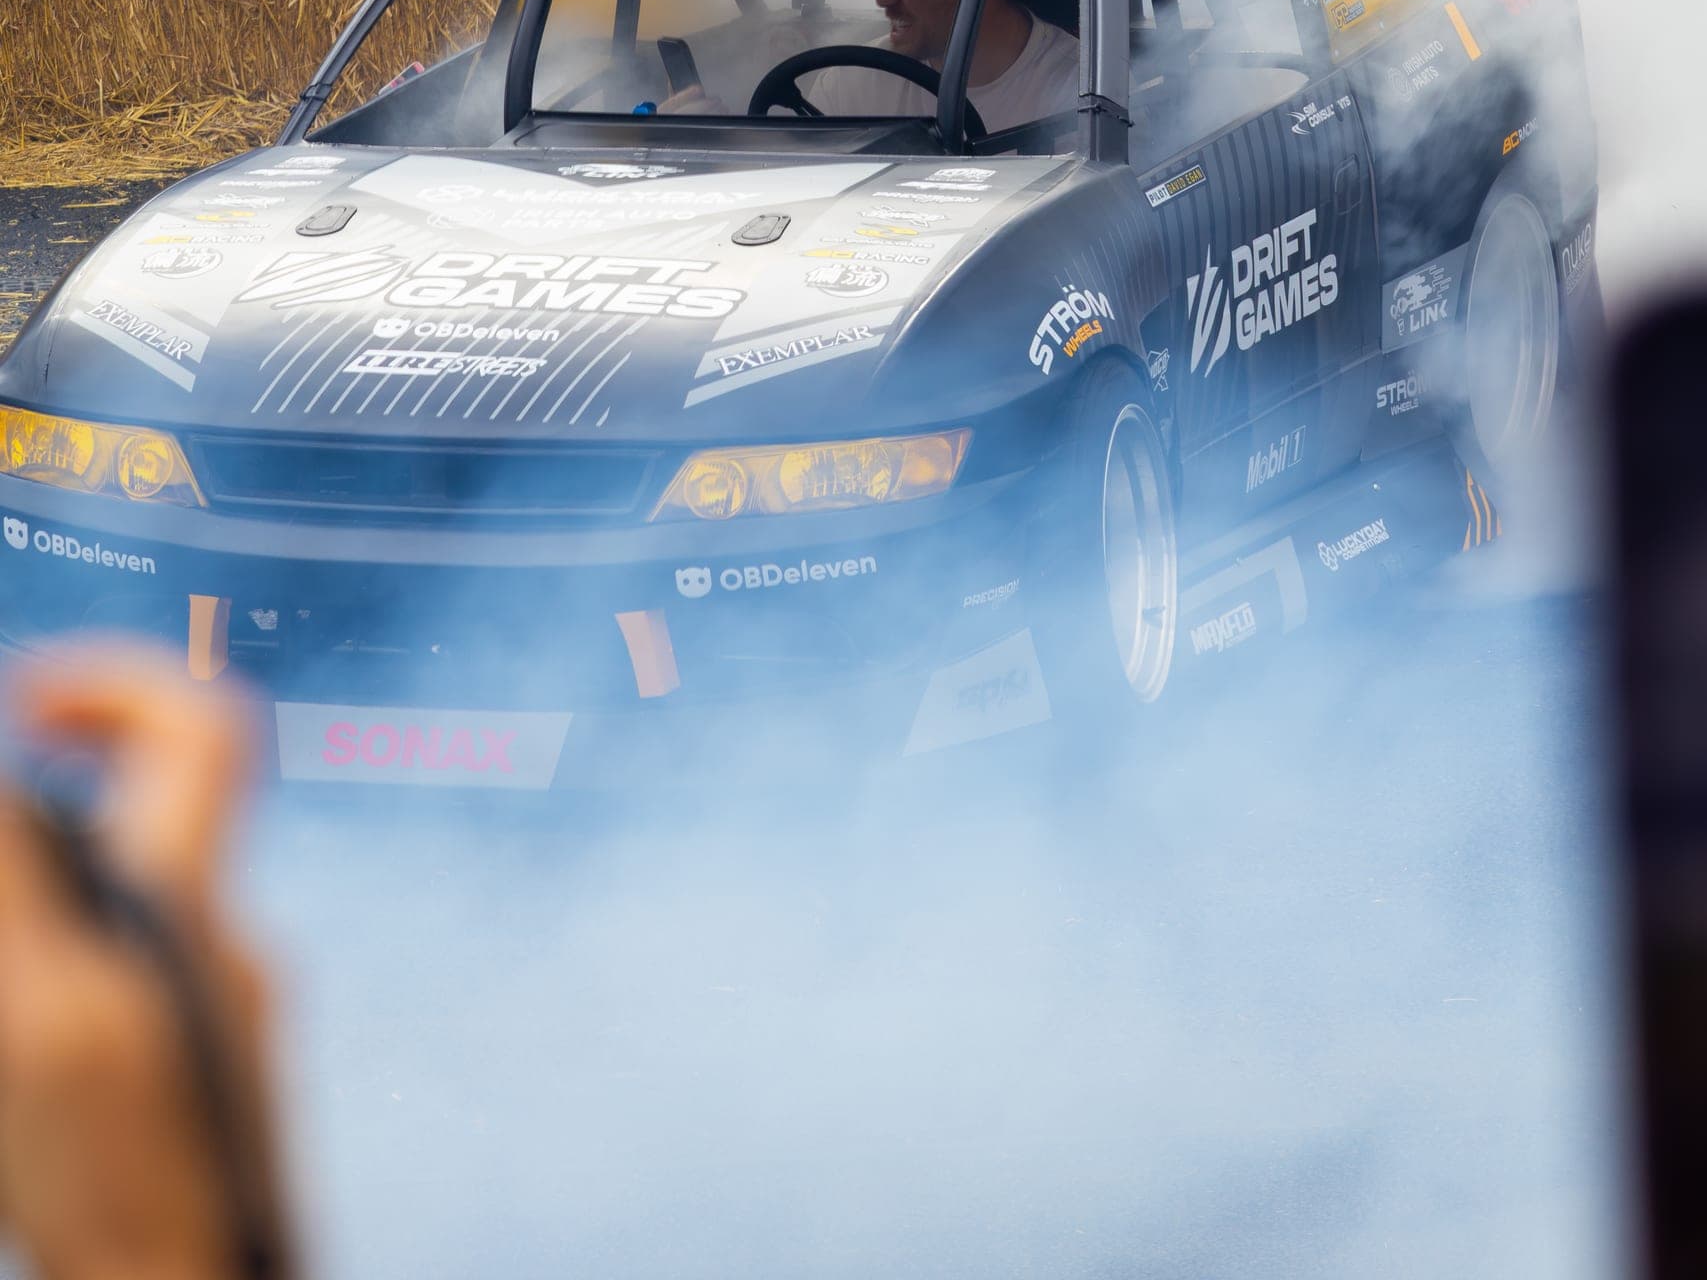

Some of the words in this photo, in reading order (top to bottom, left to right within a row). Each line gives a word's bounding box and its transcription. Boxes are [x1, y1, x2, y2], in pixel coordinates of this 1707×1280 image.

[1502, 129, 1520, 156] BC
[411, 251, 713, 286] DRIFT
[855, 252, 930, 265] RACING
[1231, 208, 1317, 299] DRIFT
[387, 275, 748, 320] GAMES
[1235, 254, 1339, 351] GAMES
[1410, 299, 1448, 332] LINK
[85, 300, 196, 361] EXEMPLAR
[414, 321, 560, 342] OBDeleven
[716, 324, 876, 377] EXEMPLAR
[1029, 284, 1116, 376] STRÖM
[1063, 319, 1103, 357] WHEELS
[1245, 434, 1289, 494] Mobil
[34, 529, 156, 575] OBDeleven
[720, 553, 877, 592] OBDeleven
[962, 577, 1020, 609] PRECISION
[321, 721, 519, 774] SONAX
